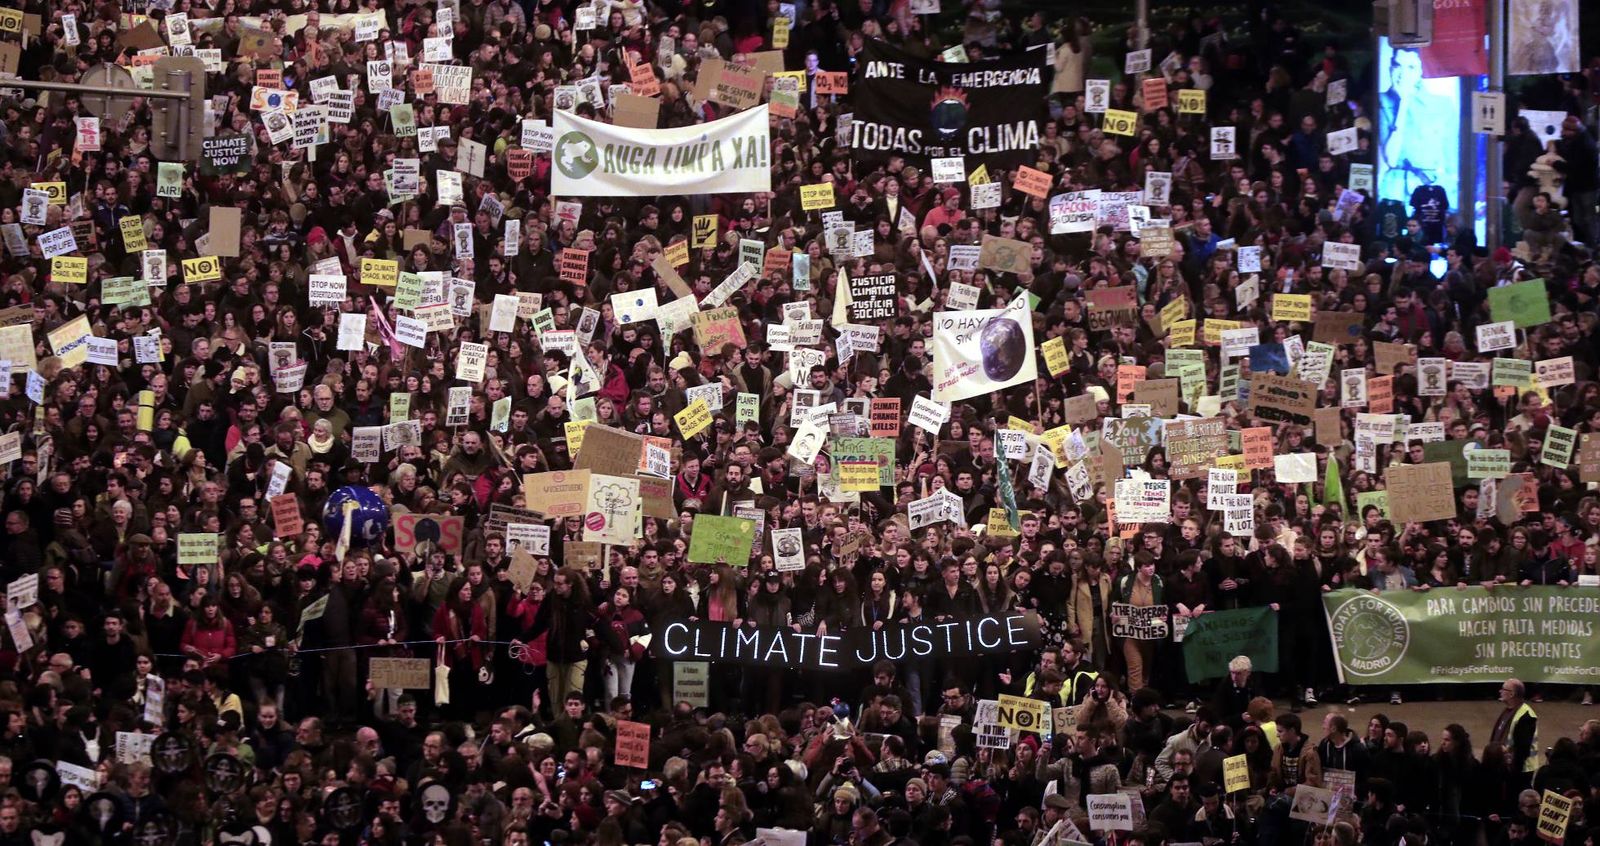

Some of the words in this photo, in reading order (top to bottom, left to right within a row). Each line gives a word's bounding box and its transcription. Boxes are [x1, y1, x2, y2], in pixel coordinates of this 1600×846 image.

[865, 61, 904, 78] ANTE
[919, 68, 938, 84] LA
[952, 68, 1041, 87] EMERGENCIA
[834, 77, 847, 88] NO!
[296, 127, 319, 136] EARTH'S
[396, 126, 415, 135] AIR!
[851, 120, 922, 153] TODAS
[925, 146, 944, 156] POR
[950, 147, 965, 156] EL
[968, 121, 1040, 154] CLIMA
[203, 138, 247, 149] CLIMATE
[204, 148, 247, 157] JUSTICE
[604, 142, 657, 174] AUGA
[733, 134, 766, 169] XA!
[213, 156, 239, 165] NOW
[158, 187, 180, 195] AIR!
[1051, 203, 1097, 213] FRACKING
[1062, 213, 1094, 223] COLOMBIA
[122, 219, 140, 229] STOP
[124, 229, 144, 239] TRUMP
[41, 236, 52, 245] WE
[44, 245, 59, 253] FOR
[564, 253, 587, 261] CLIMATE
[64, 262, 85, 270] CLIMATE
[184, 260, 219, 277] NO!
[373, 264, 395, 273] CLIMATE
[311, 280, 328, 289] STOP
[329, 281, 344, 289] NOW
[402, 276, 421, 286] Doesn't
[851, 275, 895, 286] JUSTICIA
[852, 300, 894, 309] JUSTICIA
[1293, 300, 1309, 308] NOW
[854, 309, 894, 319] SOCIAL!
[958, 315, 982, 329] HAY
[862, 331, 876, 339] NOW
[1482, 325, 1507, 336] DENIAL
[956, 333, 972, 345] SIN
[462, 343, 486, 352] JUSTICIA
[1548, 362, 1571, 370] CLIMATE
[686, 403, 705, 418] CLIMATE
[873, 402, 898, 410] CLIMATE
[915, 400, 942, 418] Consumption
[741, 408, 754, 416] OVER
[872, 412, 898, 420] CHANGE
[872, 422, 897, 430] KILLS!
[1409, 426, 1420, 435] WE
[1114, 438, 1137, 446] CAN
[1244, 434, 1258, 444] Don't
[1258, 434, 1270, 443] wait
[835, 438, 864, 453] MAKE
[649, 449, 668, 463] DENIAL
[648, 462, 654, 471] IS
[1246, 458, 1256, 466] too
[1223, 472, 1234, 480] RICH
[1211, 484, 1234, 493] POLLUTE
[1212, 496, 1217, 504] A
[1226, 498, 1237, 507] THE
[1237, 498, 1250, 507] RICH
[1228, 510, 1251, 520] POLLUTE
[1229, 522, 1234, 530] A
[395, 515, 462, 548] SOS
[1113, 604, 1129, 617] THE
[1129, 605, 1168, 619] EMPEROR
[1427, 599, 1456, 615] PARA
[1463, 598, 1515, 612] CAMBIOS
[1523, 599, 1543, 612] SIN
[1336, 603, 1358, 649] FRIDAYS
[1360, 599, 1383, 613] FOR
[1383, 607, 1404, 648] FUTURE
[1459, 621, 1496, 637] HACEN
[1503, 620, 1535, 635] FALTA
[1541, 620, 1592, 636] MEDIDAS
[1114, 625, 1164, 638] CLOTHES
[664, 622, 842, 667] CLIMATE
[856, 615, 1028, 662] JUSTICE
[1475, 643, 1495, 659] SIN
[1502, 642, 1582, 659] PRECEDENTES
[1351, 656, 1391, 670] MADRID
[1430, 665, 1514, 676] #FridaysForFuture
[998, 708, 1041, 728] NO!
[618, 729, 634, 738] Don't
[635, 729, 649, 740] wait
[983, 725, 992, 734] NO
[993, 726, 1005, 735] TIME
[620, 741, 633, 751] until
[634, 741, 643, 751] it's
[979, 736, 986, 746] TO
[987, 735, 1007, 748] WASTE!
[617, 752, 627, 761] too
[1090, 801, 1126, 811] Consumption
[1545, 794, 1570, 812] CLIMATE
[1116, 813, 1129, 822] you
[1542, 808, 1567, 823] CAN'T
[1540, 820, 1564, 836] WAIT!
